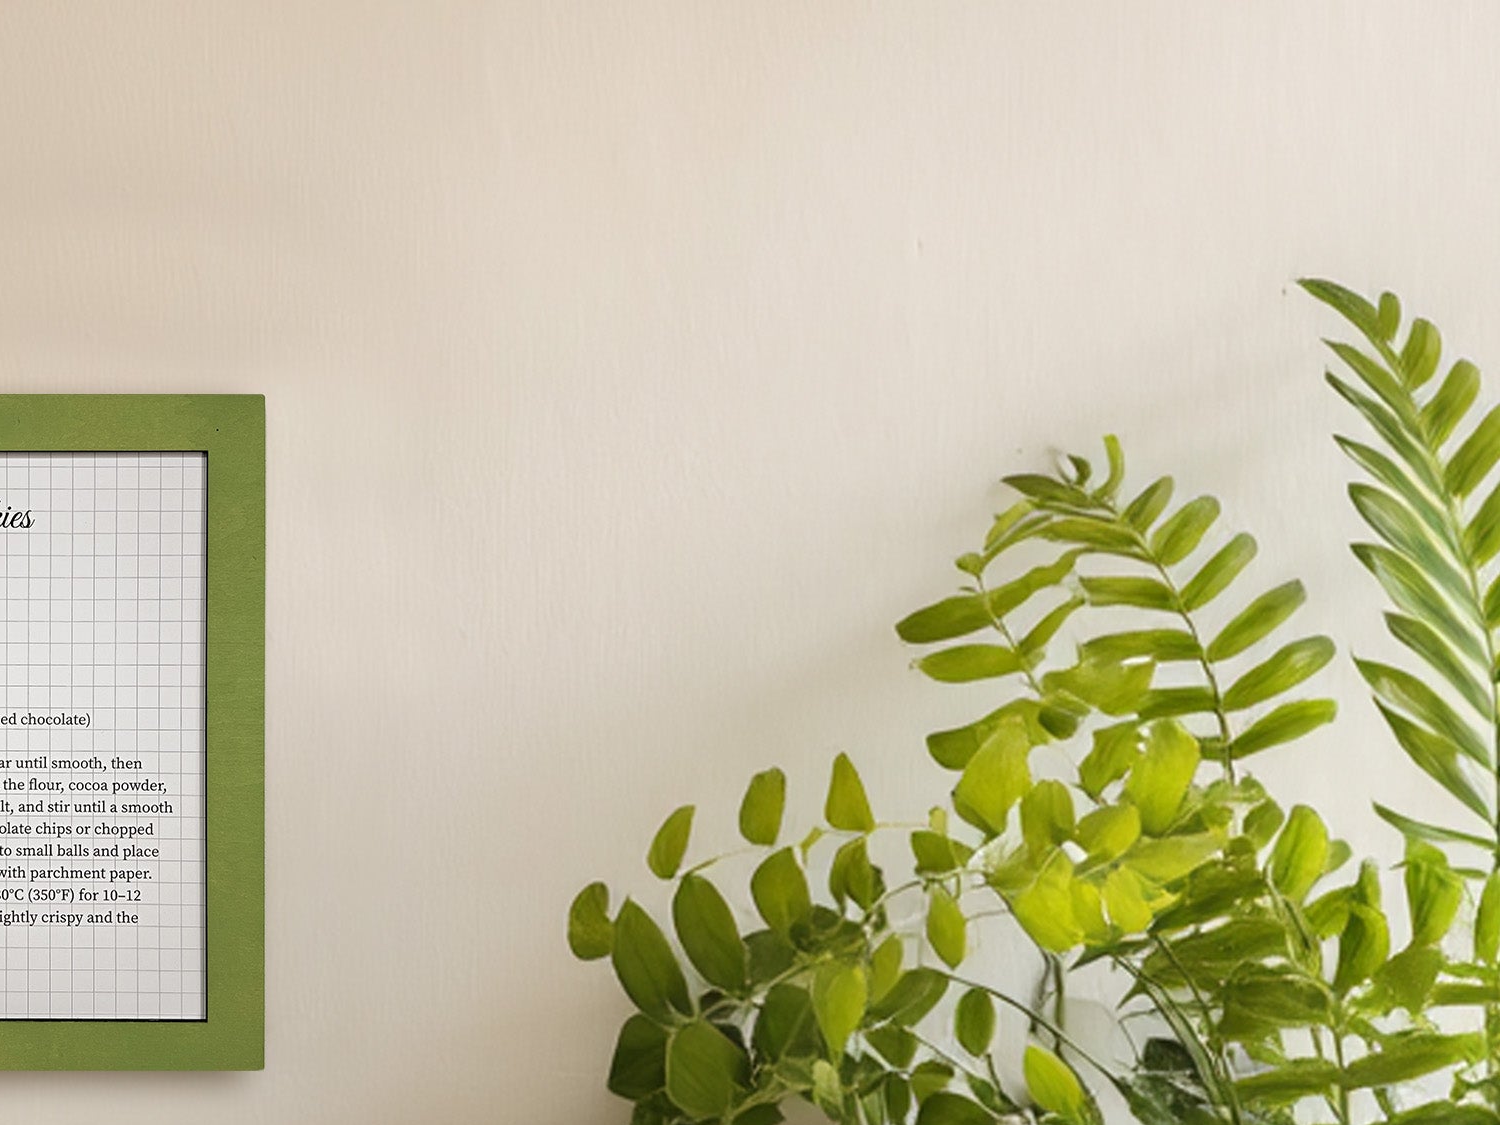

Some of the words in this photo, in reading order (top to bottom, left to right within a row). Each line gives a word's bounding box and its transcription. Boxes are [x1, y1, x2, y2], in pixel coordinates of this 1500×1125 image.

[20, 712, 91, 728] chocolate)
[15, 756, 48, 769] until
[51, 756, 107, 773] smooth,
[110, 756, 142, 770] then
[2, 777, 25, 791] the
[29, 777, 65, 794] flour,
[68, 781, 109, 791] cocoa
[112, 778, 167, 795] powder,
[18, 799, 44, 813] and
[47, 800, 71, 813] stir
[73, 800, 106, 813] until
[109, 803, 118, 813] a
[121, 800, 173, 814] smooth
[35, 821, 73, 839] chips
[75, 825, 91, 835] or
[94, 822, 154, 839] chopped
[15, 843, 53, 857] small
[57, 843, 90, 857] balls
[92, 844, 119, 857] and
[122, 844, 160, 861] place
[30, 865, 106, 883] parchment
[109, 869, 152, 883] paper.
[78, 887, 100, 902] for
[41, 910, 84, 927] crispy
[86, 910, 113, 924] and
[116, 910, 139, 924] the
